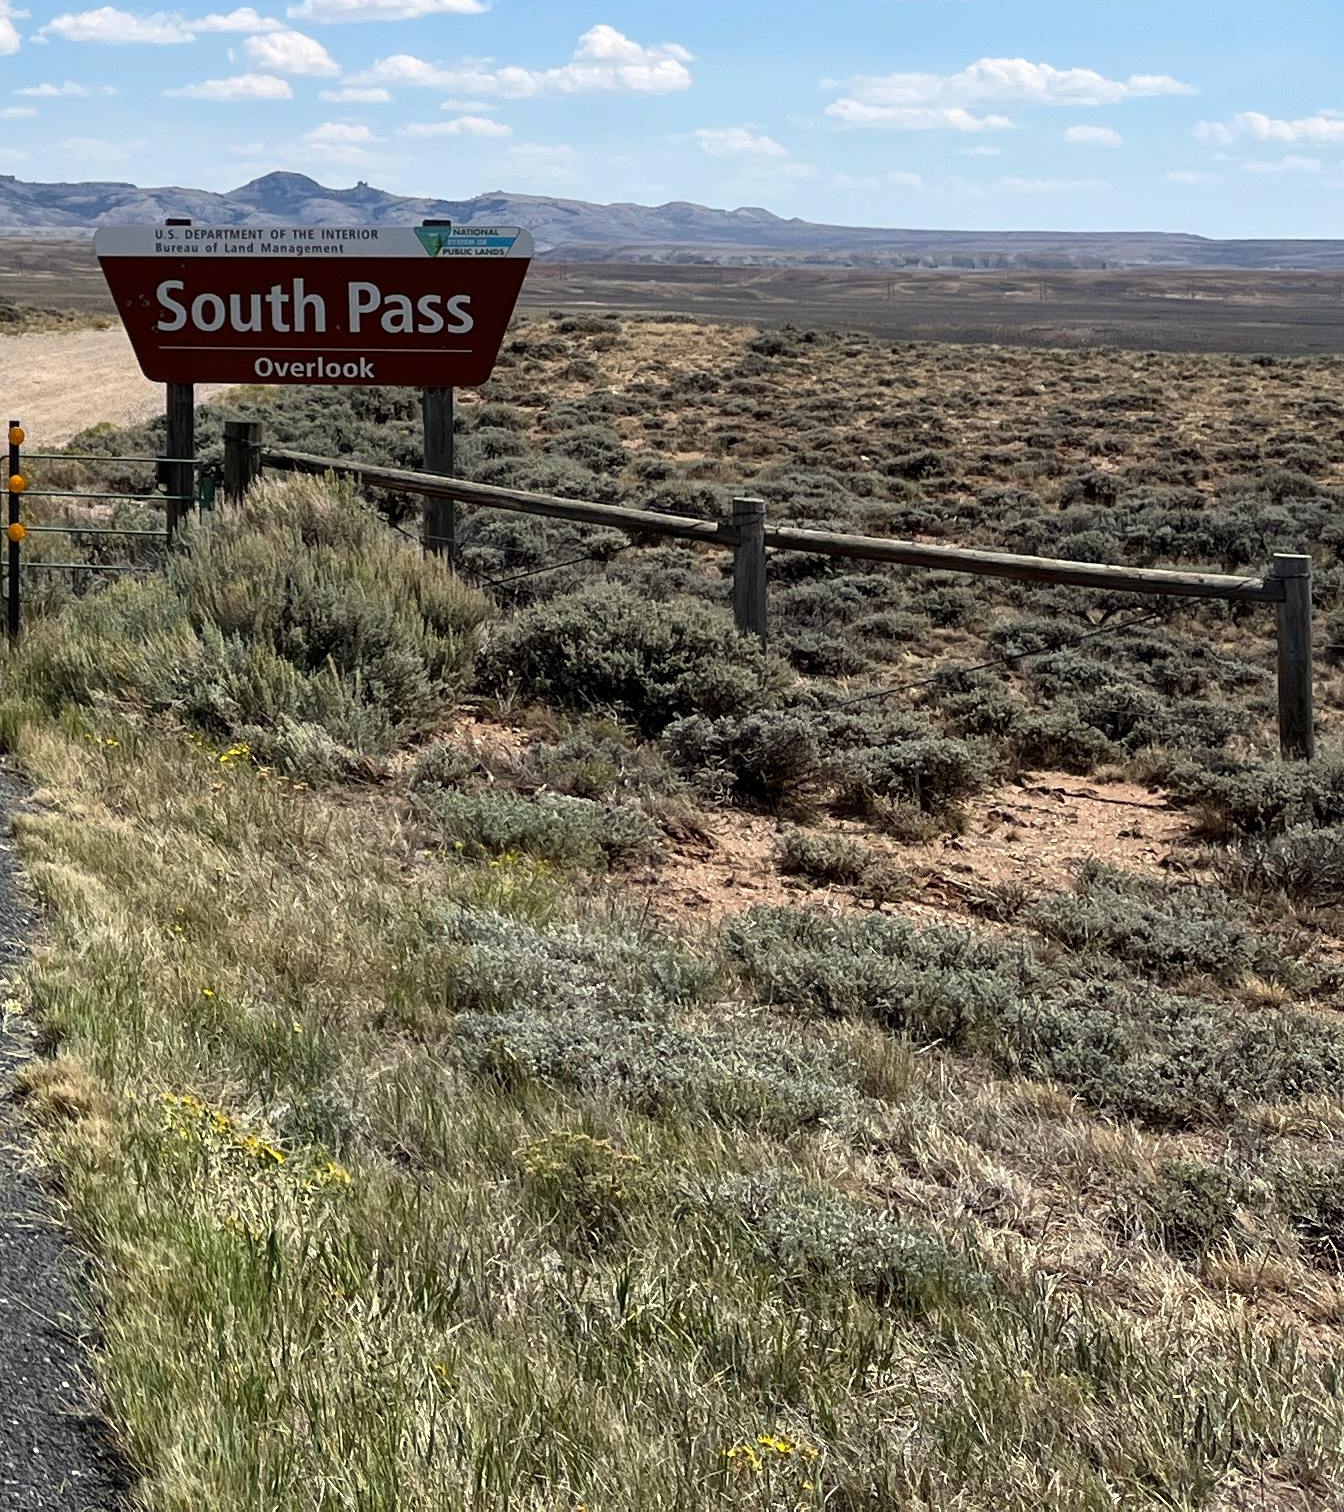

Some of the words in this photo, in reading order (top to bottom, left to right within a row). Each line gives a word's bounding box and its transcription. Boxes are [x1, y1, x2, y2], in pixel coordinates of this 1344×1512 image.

[185, 229, 263, 240] DEPARTMENT
[271, 229, 286, 240] OF
[293, 229, 314, 240] THE
[321, 229, 378, 240] INTERIOR
[454, 228, 499, 236] NATIONAL
[155, 242, 199, 253] Bureau
[205, 242, 218, 253] of
[224, 242, 254, 253] Land
[261, 242, 344, 256] Management
[443, 248, 472, 256] PUBLIC
[475, 248, 504, 256] LANDS
[155, 277, 327, 335] South
[348, 280, 475, 335] Pass
[254, 356, 375, 379] Overlook
